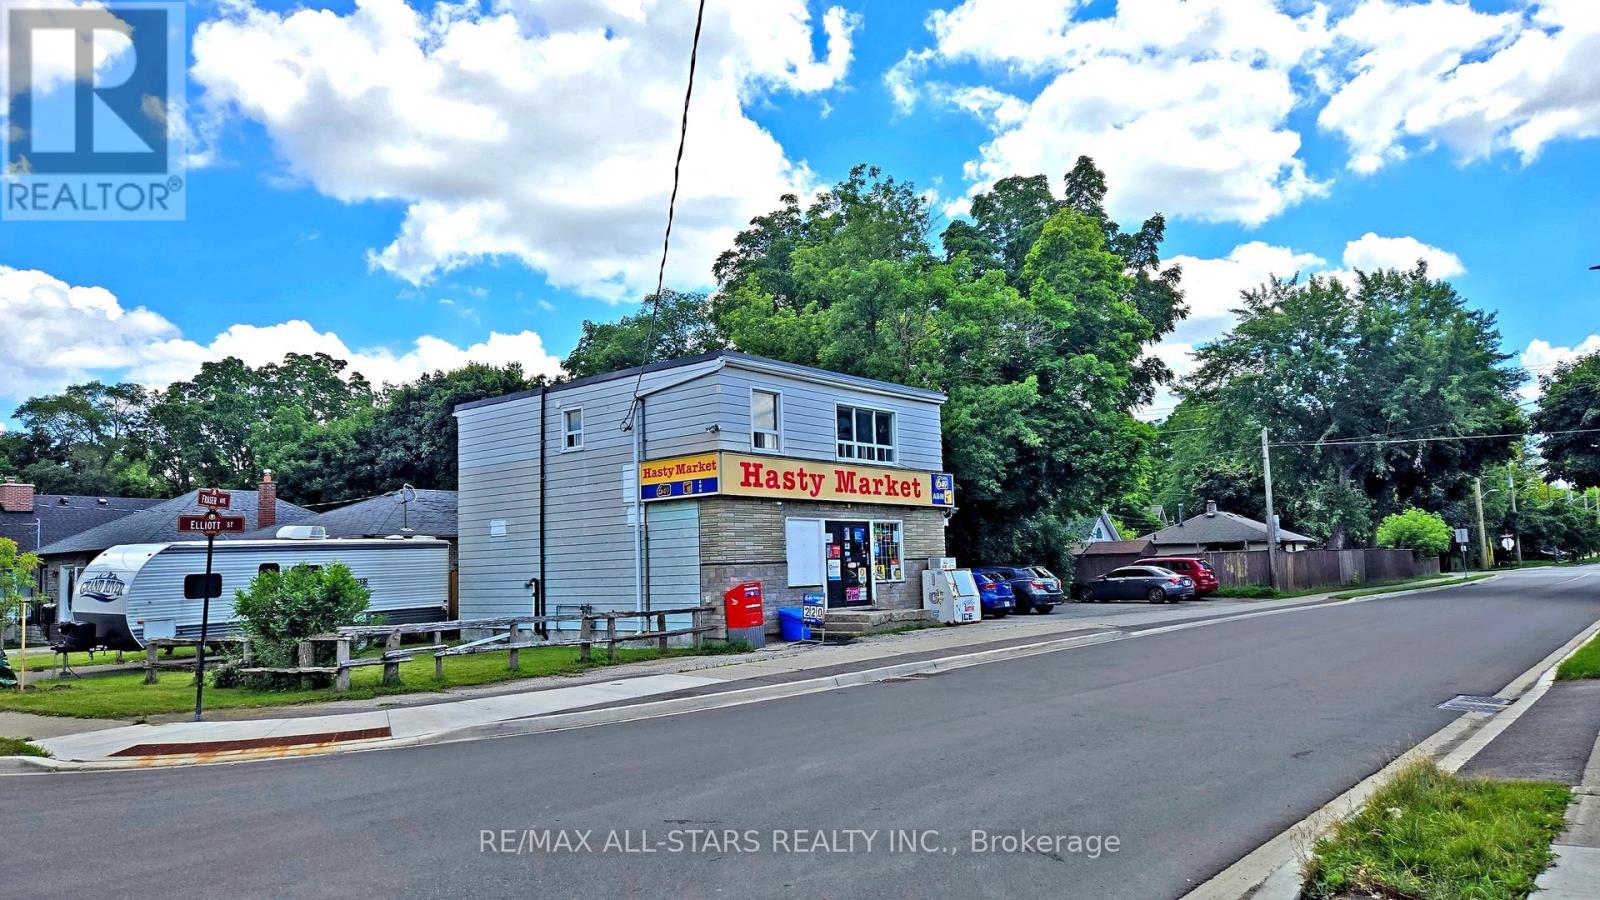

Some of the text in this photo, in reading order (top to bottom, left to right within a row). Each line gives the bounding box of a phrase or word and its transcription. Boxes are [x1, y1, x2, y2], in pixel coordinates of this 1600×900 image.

[643, 459, 717, 478] Hasty Market
[740, 461, 921, 498] Hasty Market
[201, 495, 217, 505] FRASER
[190, 520, 221, 530] ELLIOTT
[80, 579, 125, 596] GRAND RIVER
